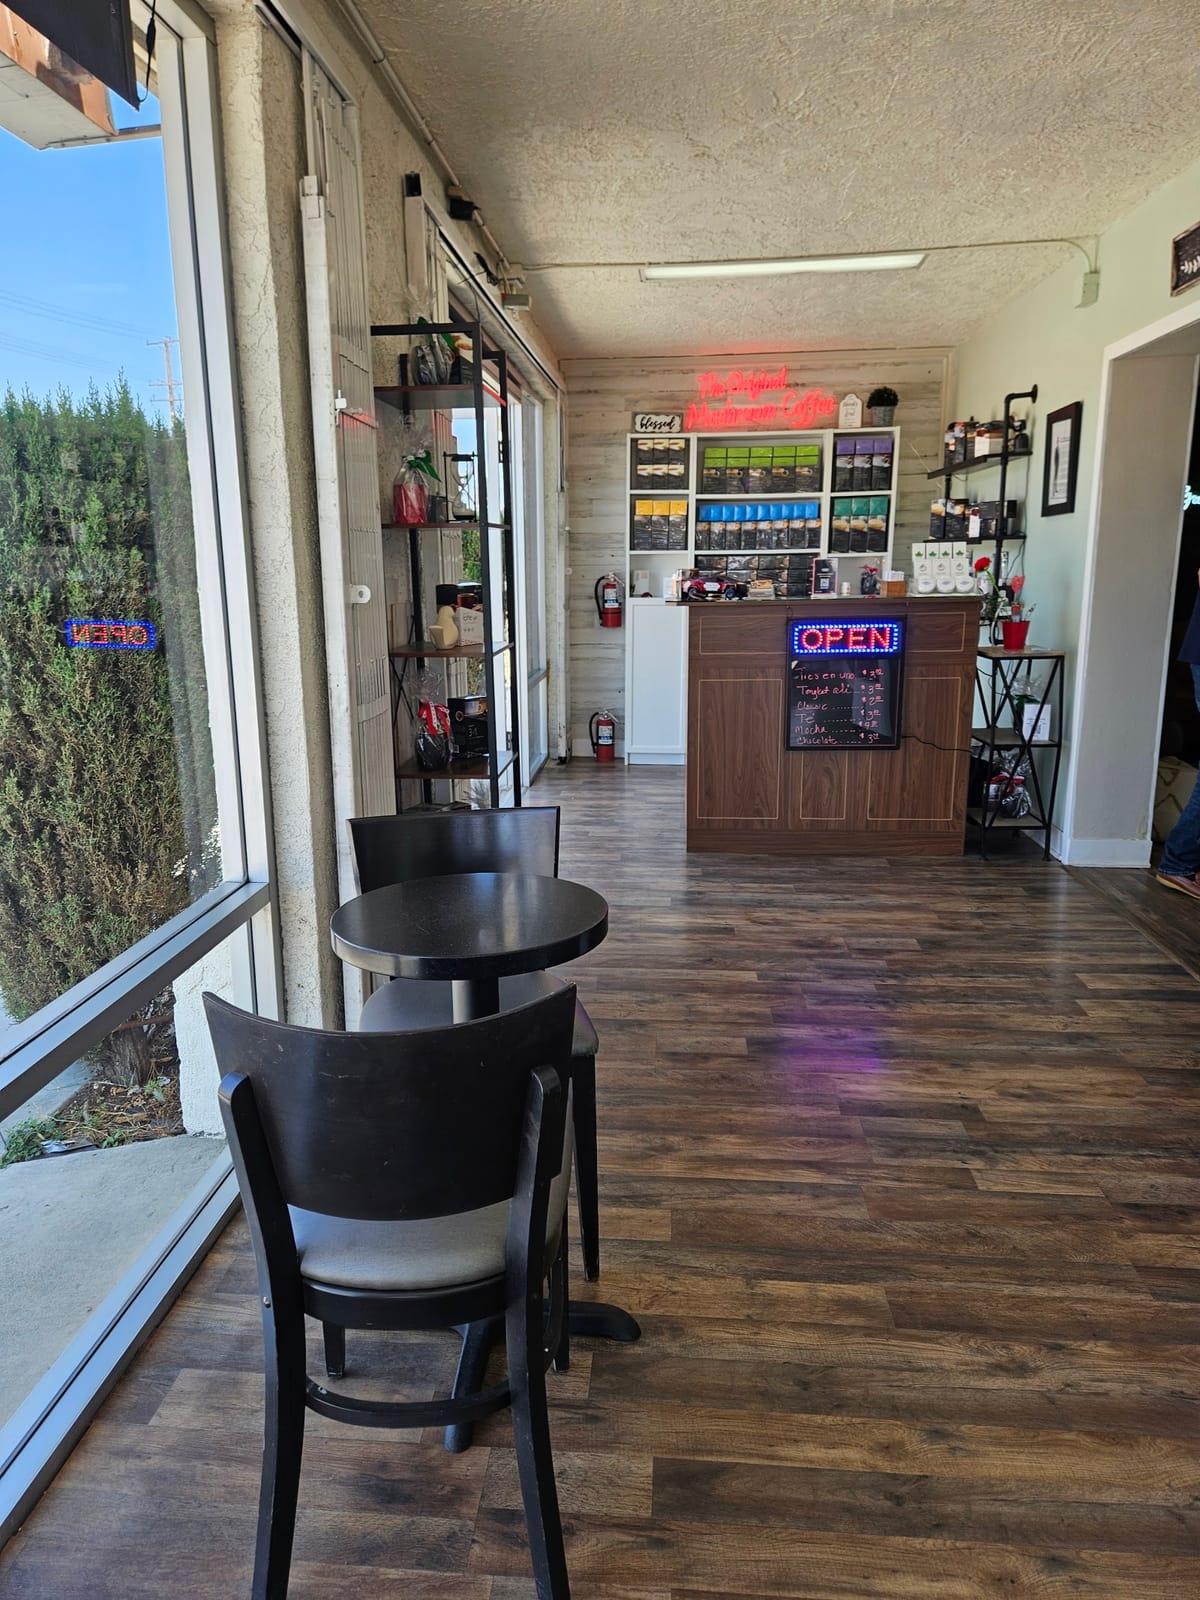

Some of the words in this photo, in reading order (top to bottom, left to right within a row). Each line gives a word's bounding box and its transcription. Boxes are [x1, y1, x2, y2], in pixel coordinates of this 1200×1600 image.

[699, 374, 725, 398] The
[728, 367, 787, 400] Original
[640, 416, 675, 430] blessed
[687, 399, 777, 430] Mushroom
[782, 391, 835, 425] Coffee
[801, 627, 891, 650] OPEN
